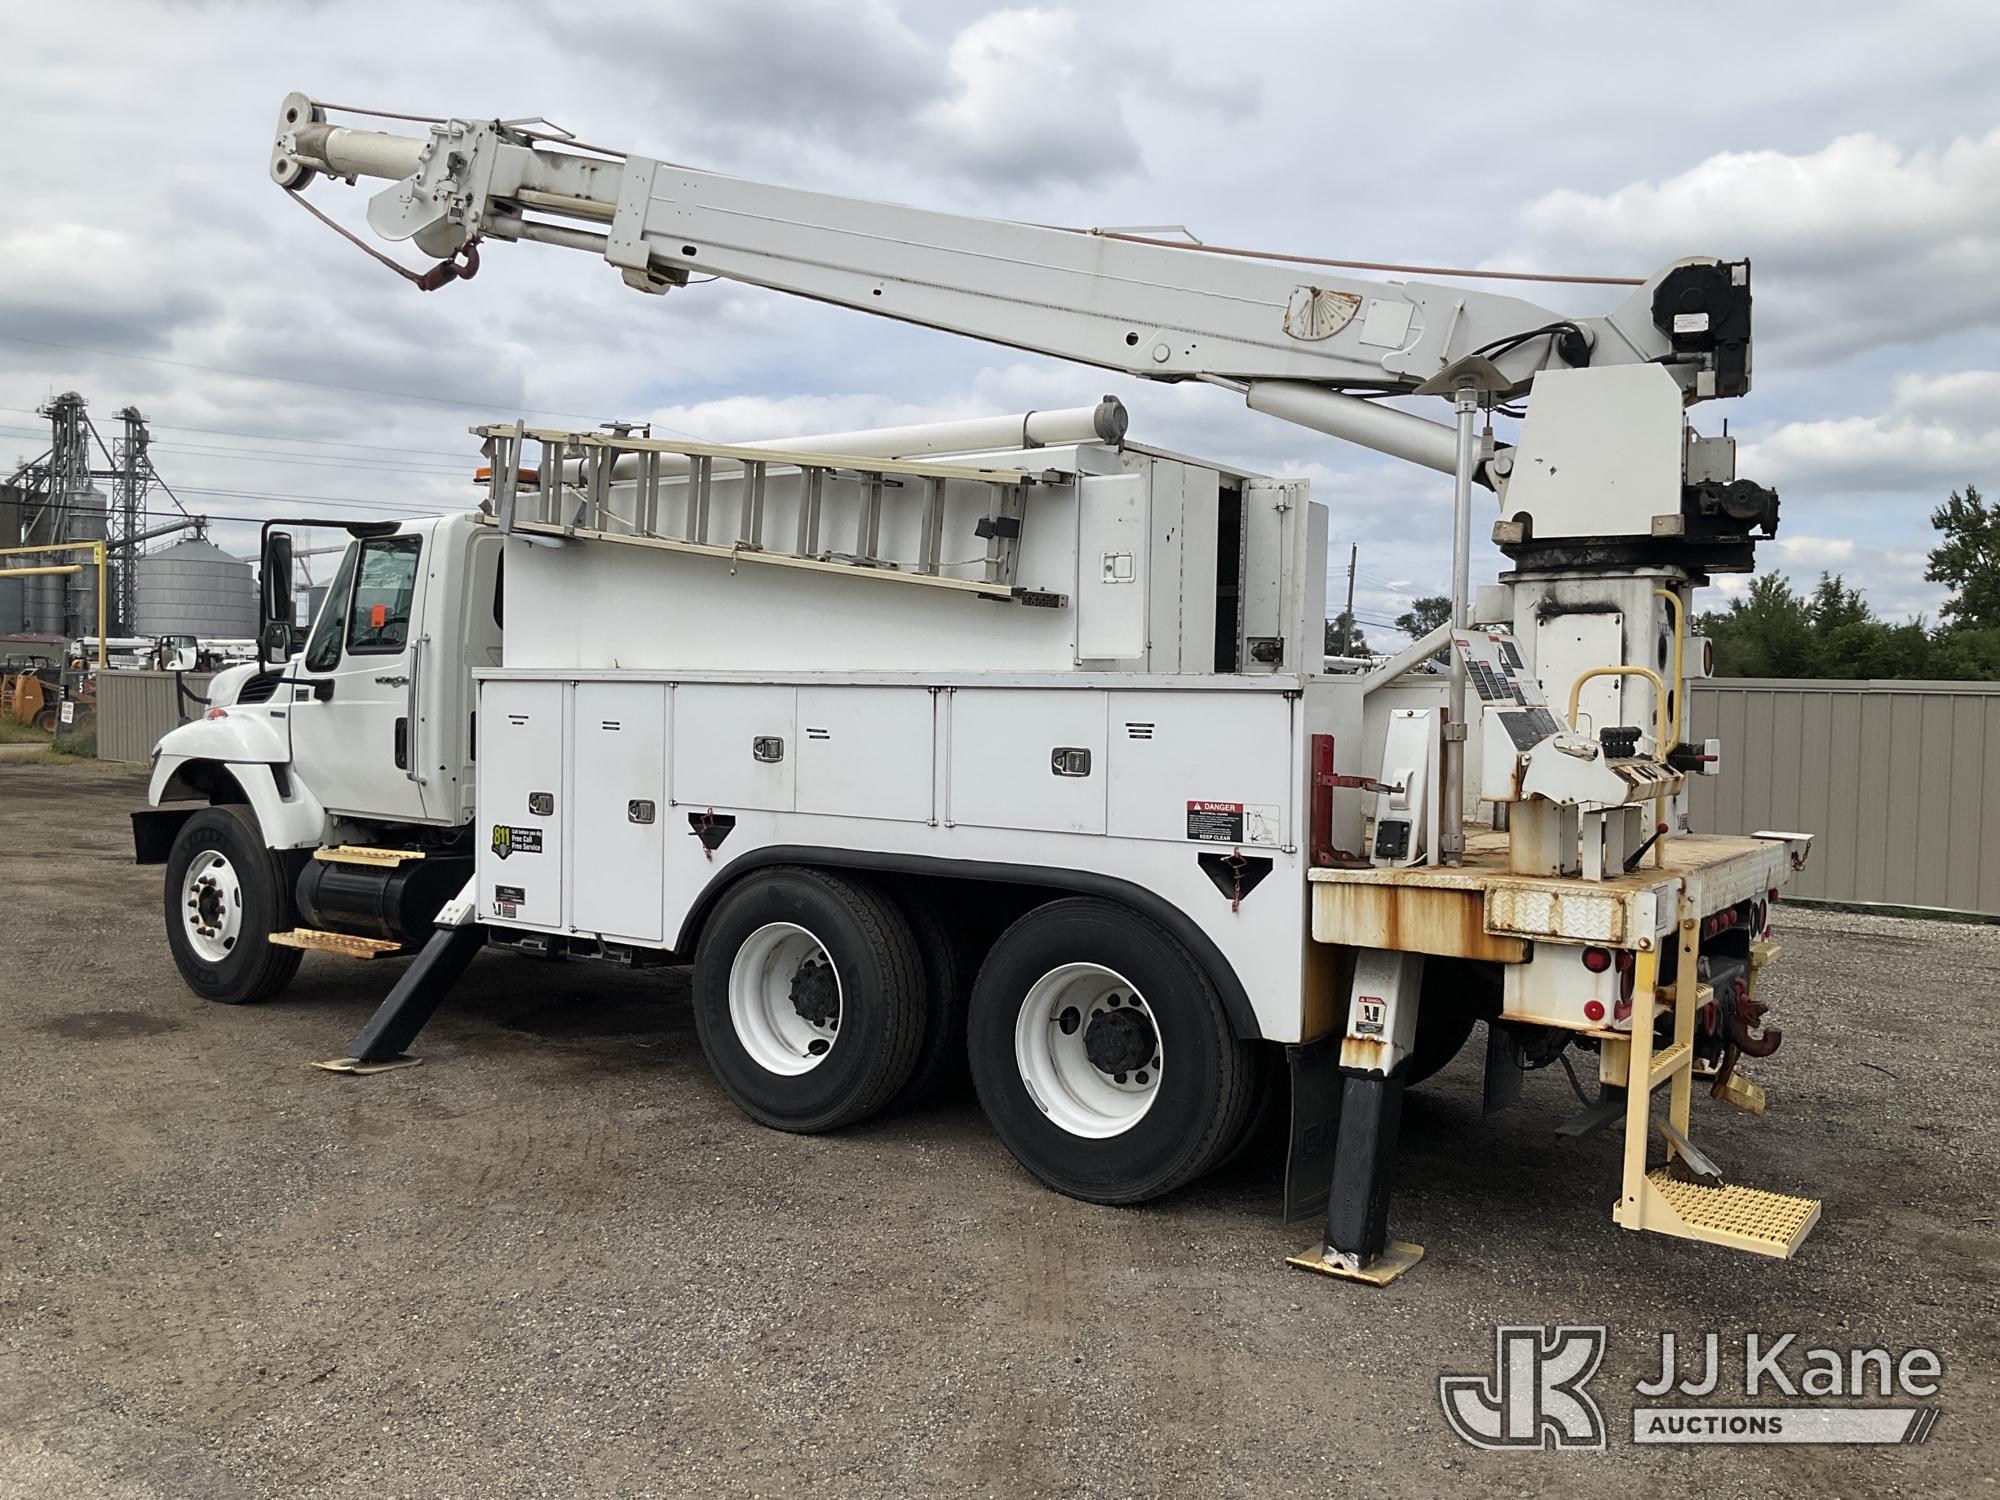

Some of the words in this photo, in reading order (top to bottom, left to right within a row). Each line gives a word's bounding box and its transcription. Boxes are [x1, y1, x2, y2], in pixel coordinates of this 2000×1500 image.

[1204, 803, 1235, 811] DANGER
[494, 826, 510, 846] 811
[523, 843, 541, 851] Service
